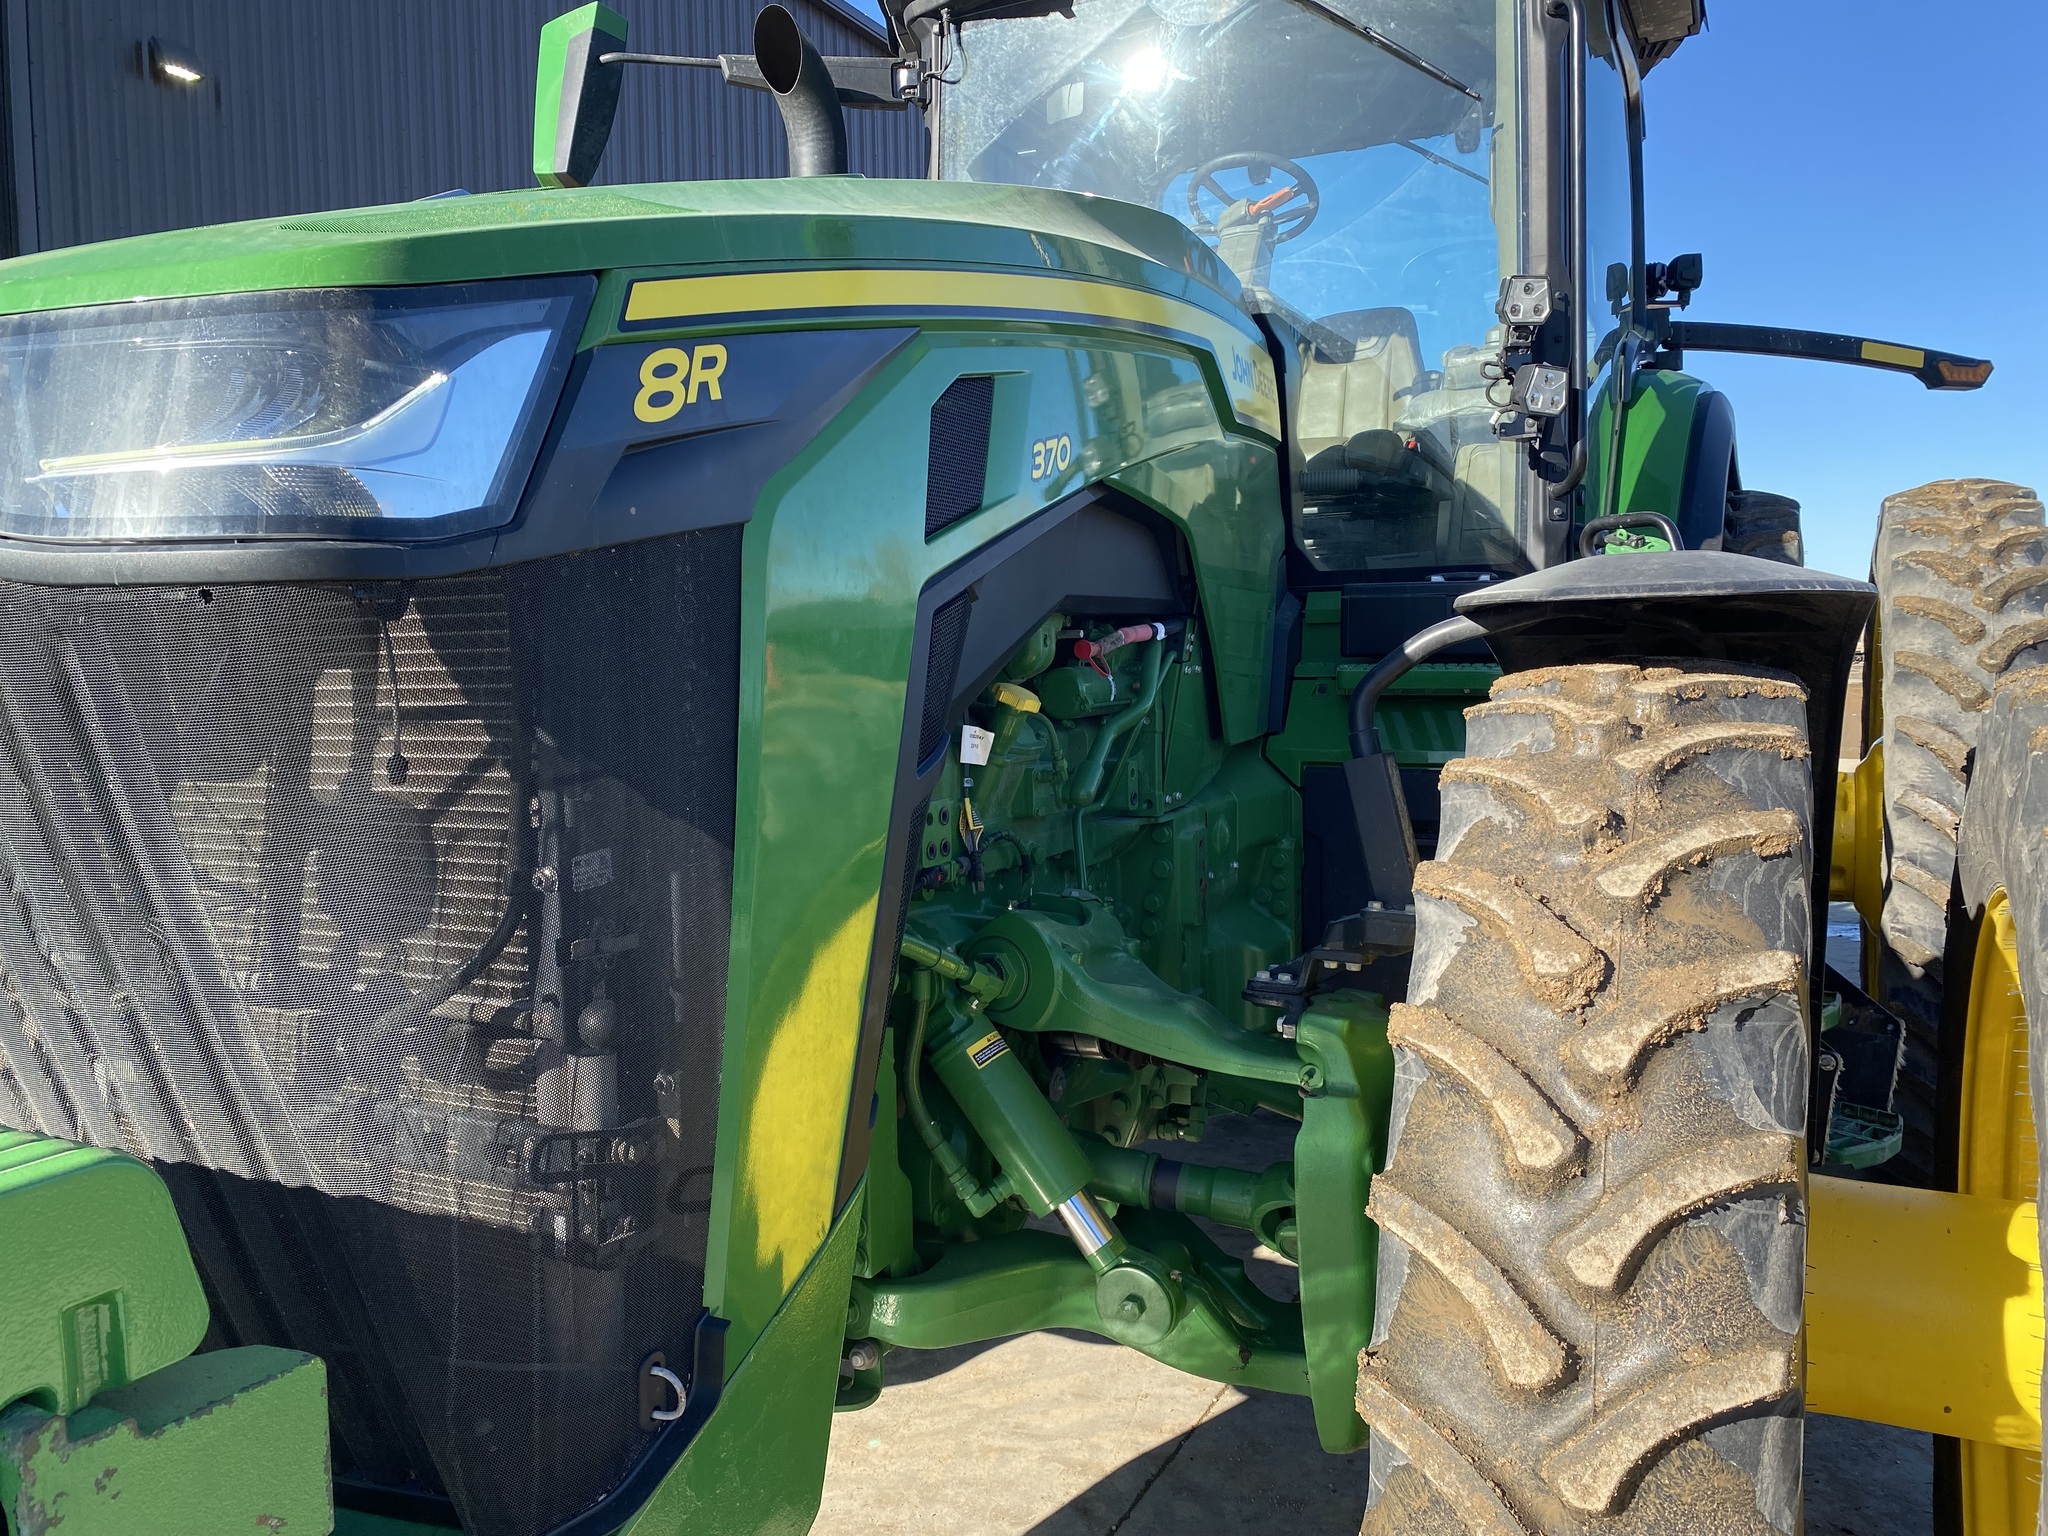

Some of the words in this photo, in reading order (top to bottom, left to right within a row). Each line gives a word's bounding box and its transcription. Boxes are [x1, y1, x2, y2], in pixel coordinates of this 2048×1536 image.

[633, 343, 728, 423] 8R
[1231, 345, 1254, 390] JOHN
[1252, 359, 1276, 405] DEERE
[1031, 432, 1071, 482] 370
